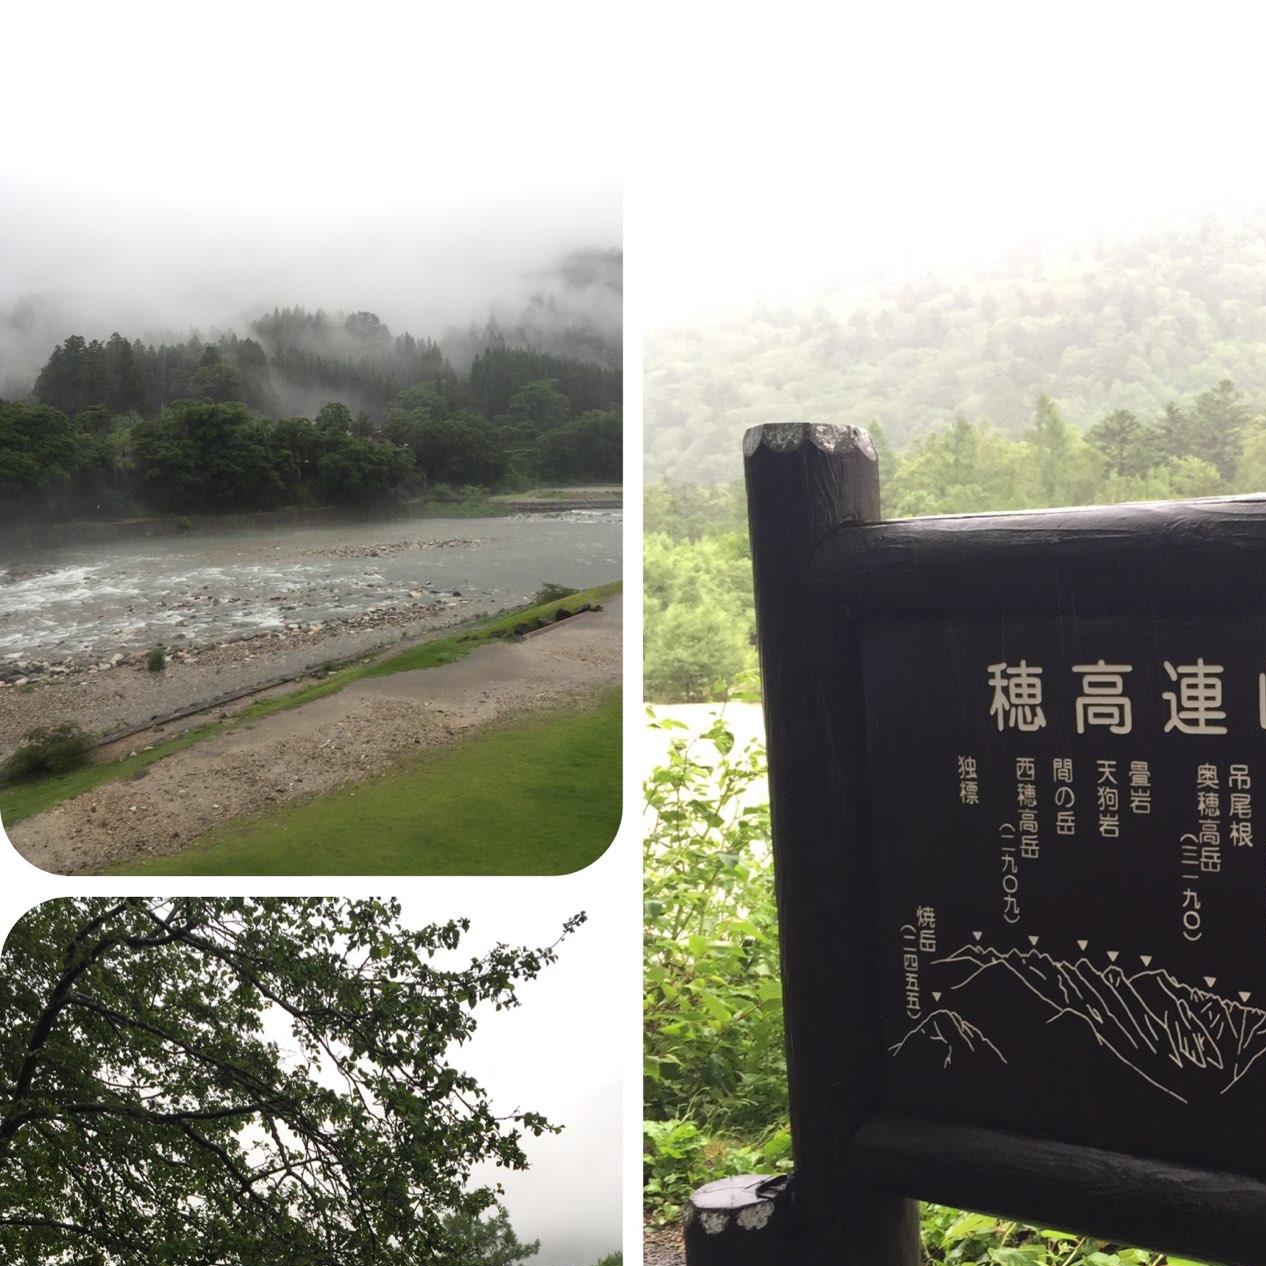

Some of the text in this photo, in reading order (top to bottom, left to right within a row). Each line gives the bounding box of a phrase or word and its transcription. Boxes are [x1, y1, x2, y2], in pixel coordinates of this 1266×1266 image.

[957, 756, 979, 804] 独標
[1016, 757, 1039, 858] 西穂高岳
[1053, 758, 1075, 834] 間の岳
[1097, 760, 1119, 837] 天狗岩
[1197, 763, 1221, 872] 奥穂高岳
[1229, 765, 1253, 847] 吊尾根
[917, 906, 936, 952] 焼岳
